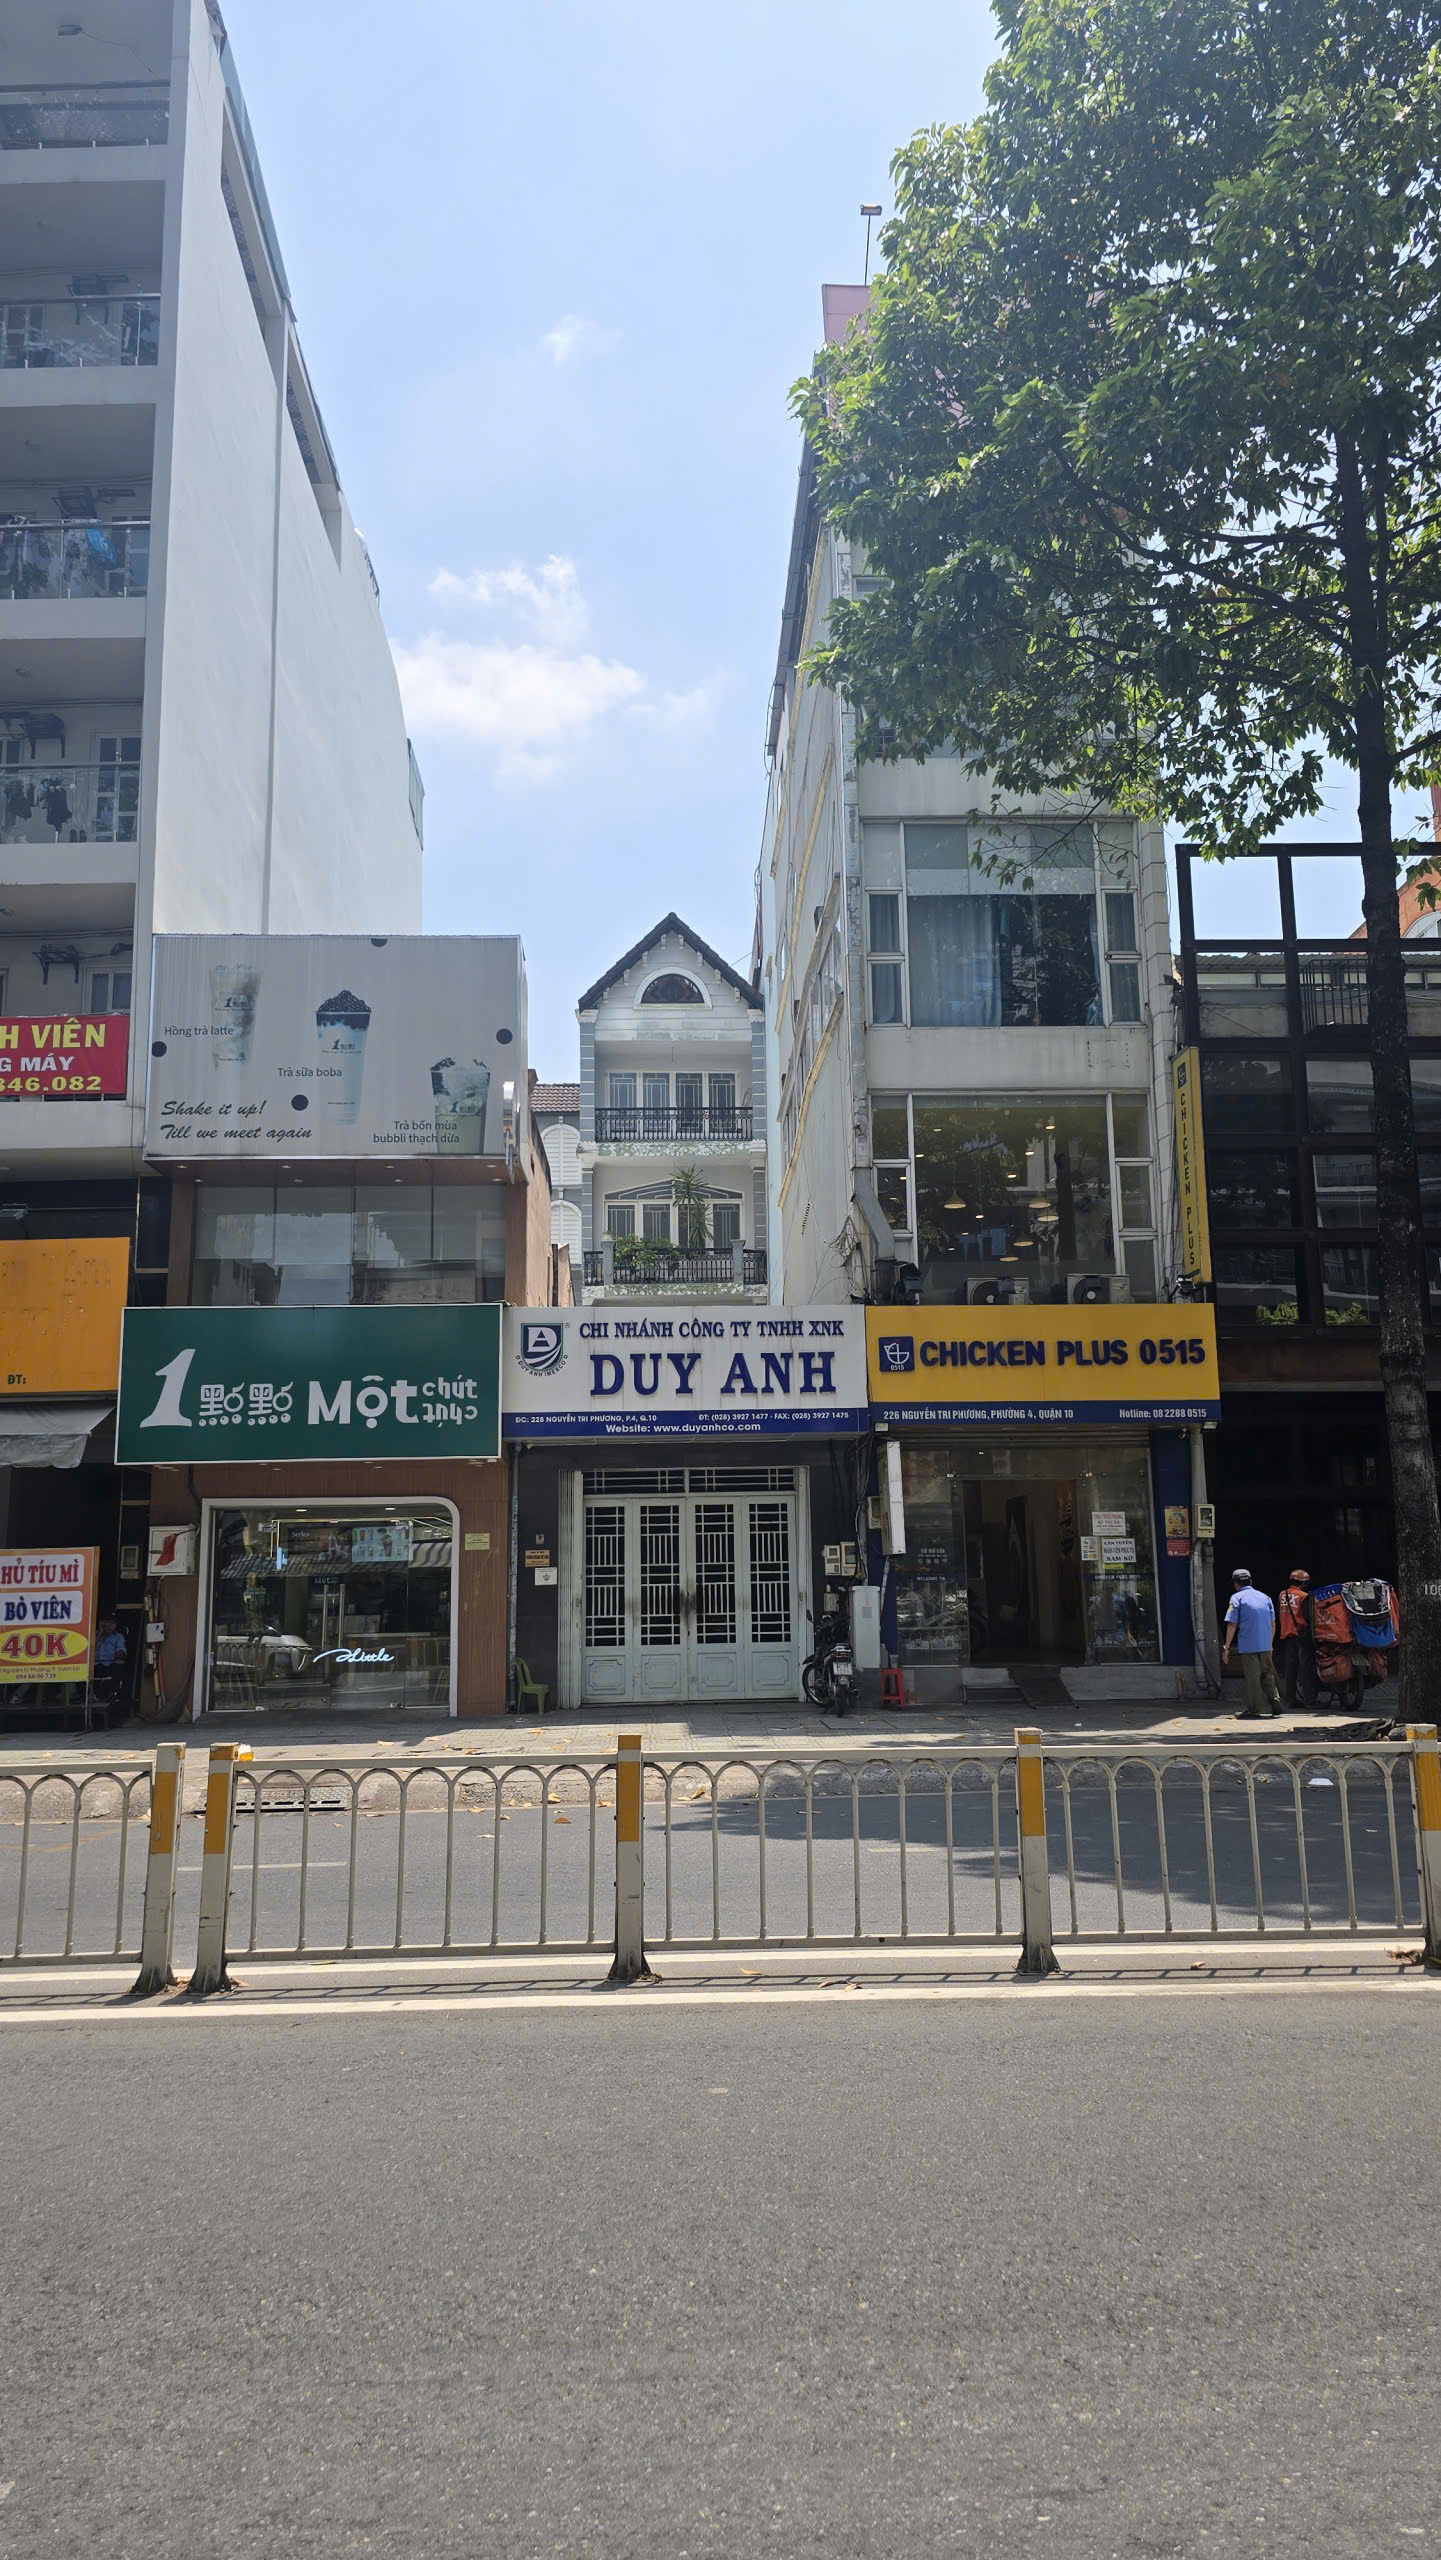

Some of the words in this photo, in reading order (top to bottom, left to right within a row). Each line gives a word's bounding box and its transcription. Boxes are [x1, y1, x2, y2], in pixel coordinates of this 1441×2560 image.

[31, 1017, 106, 1049] VIÊN
[164, 1026, 192, 1038] Hồng
[194, 1026, 208, 1036] trà
[210, 1026, 234, 1036] latte
[20, 1053, 75, 1072] MÁY
[278, 1067, 293, 1077] Trà
[296, 1067, 314, 1077] sữa
[316, 1067, 342, 1077] boba
[161, 1100, 213, 1116] Shake
[218, 1103, 232, 1115] it
[237, 1100, 267, 1118] up!
[160, 1124, 192, 1140] Till
[196, 1128, 218, 1139] we
[224, 1127, 262, 1139] meet
[266, 1127, 312, 1143] again
[394, 1120, 409, 1130] Trà
[412, 1119, 432, 1130] bốn
[435, 1120, 457, 1130] mùa
[373, 1133, 406, 1143] bubbli
[408, 1133, 438, 1145] thạch
[440, 1132, 460, 1143] dừa
[1180, 1092, 1191, 1195] CHICKEN
[1186, 1206, 1195, 1265] PLUS
[579, 1322, 608, 1338] CHI
[614, 1318, 674, 1338] NHÁNH
[679, 1317, 725, 1338] CÔNG
[730, 1321, 751, 1337] TY
[757, 1320, 804, 1336] TNHH
[808, 1320, 845, 1337] XNK
[920, 1340, 1046, 1367] CHICKEN
[1057, 1339, 1128, 1366] PLUS
[1139, 1338, 1206, 1365] 0515
[7, 1374, 27, 1385] ĐT:
[590, 1353, 702, 1396] DUY
[720, 1351, 836, 1395] ANH
[422, 1374, 478, 1399] chút
[307, 1375, 419, 1429] Một
[546, 1413, 576, 1423] NGUYỄN
[590, 1415, 624, 1423] PHƯƠNG,
[699, 1413, 710, 1421] ĐT:
[711, 1413, 730, 1421] (028)
[732, 1413, 750, 1421] 3927
[791, 1412, 811, 1421] (028)
[883, 1410, 900, 1420] 226
[901, 1406, 936, 1420] NGUYỄN
[937, 1410, 951, 1420] TRI
[1038, 1407, 1062, 1420] QUẬN
[1064, 1409, 1074, 1418] 10
[1119, 1408, 1152, 1418] Hotline:
[1153, 1408, 1164, 1418] 08
[1164, 1408, 1186, 1418] 2288
[1187, 1408, 1207, 1418] 0515
[605, 1424, 651, 1433] Website:
[653, 1423, 761, 1434] www.duyanhco.com
[1, 1557, 25, 1585] HỦ
[28, 1560, 57, 1584] TÍU
[60, 1559, 80, 1583] MÌ
[4, 1595, 28, 1622] BÒ
[31, 1594, 72, 1621] VIÊN
[2, 1632, 68, 1658] 40K
